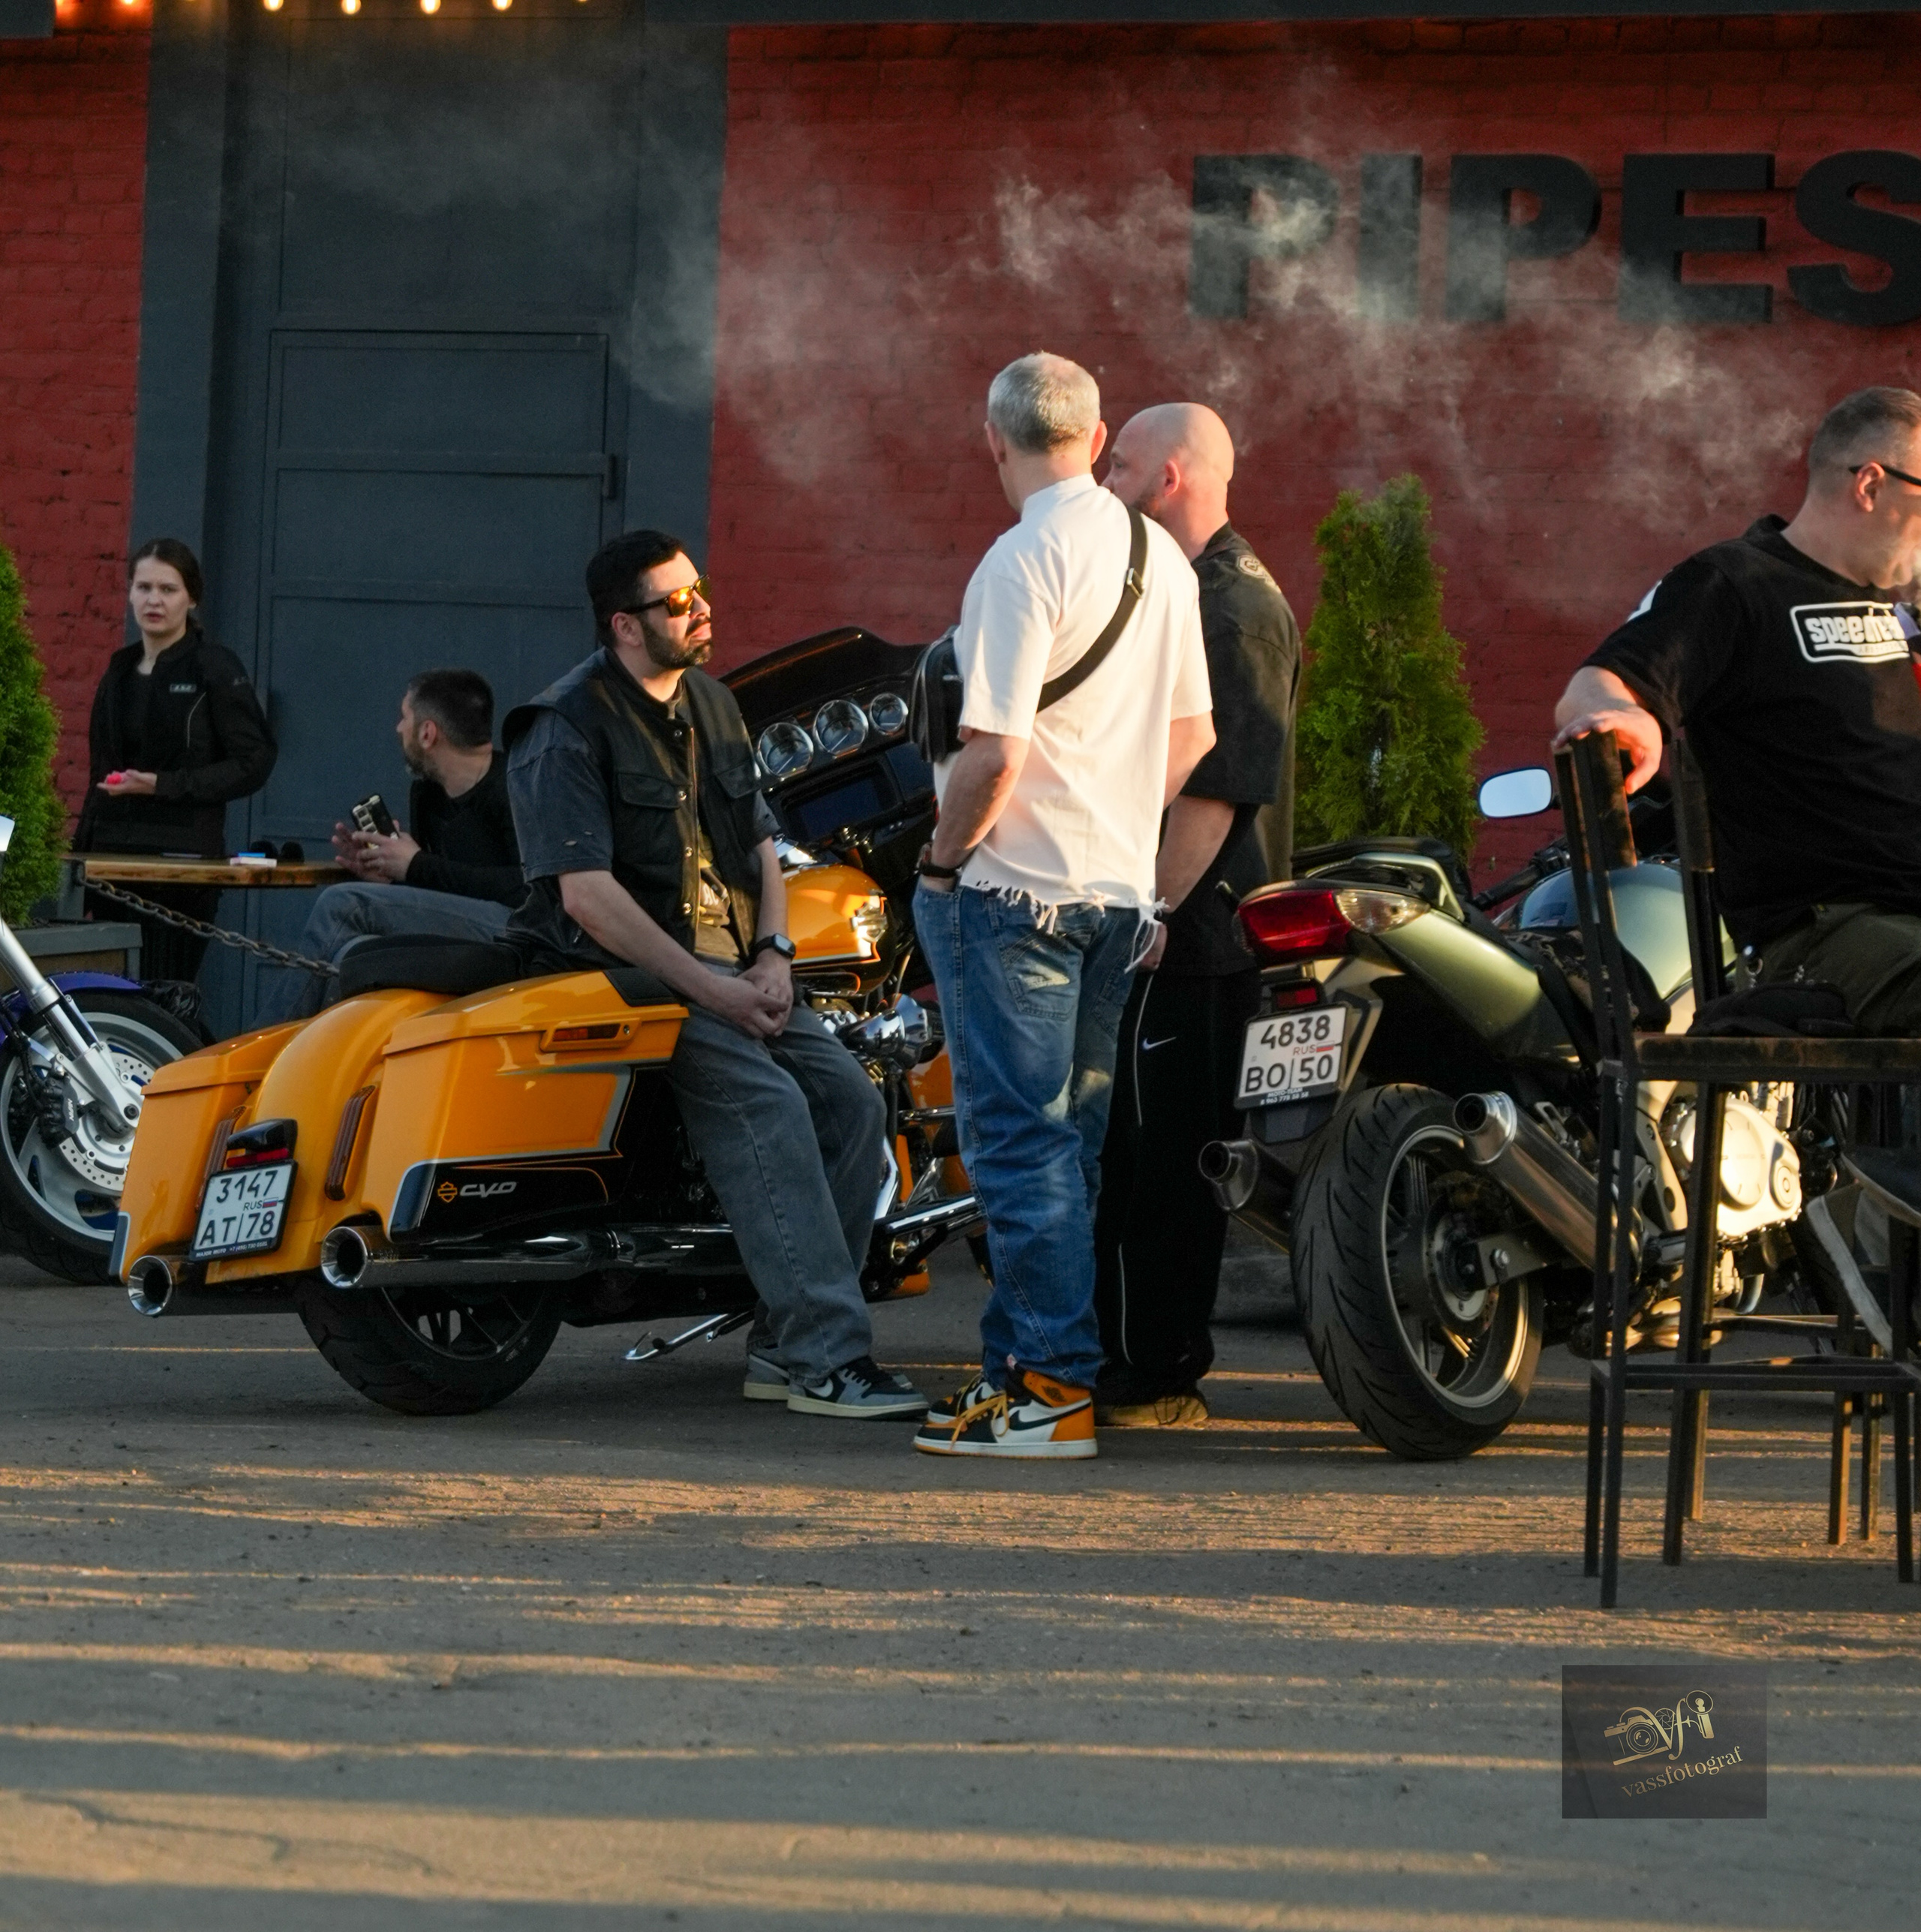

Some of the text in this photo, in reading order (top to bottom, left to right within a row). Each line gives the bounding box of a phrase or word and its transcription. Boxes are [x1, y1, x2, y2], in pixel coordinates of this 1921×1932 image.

[1189, 150, 1921, 327] PIPES
[1261, 1015, 1330, 1049] 4838
[1293, 1044, 1316, 1055] RUS
[1245, 1054, 1333, 1093] BO 50
[216, 1169, 278, 1203] 3147
[460, 1181, 517, 1198] CVO
[243, 1200, 263, 1211] RUS
[199, 1211, 275, 1246] AT 78
